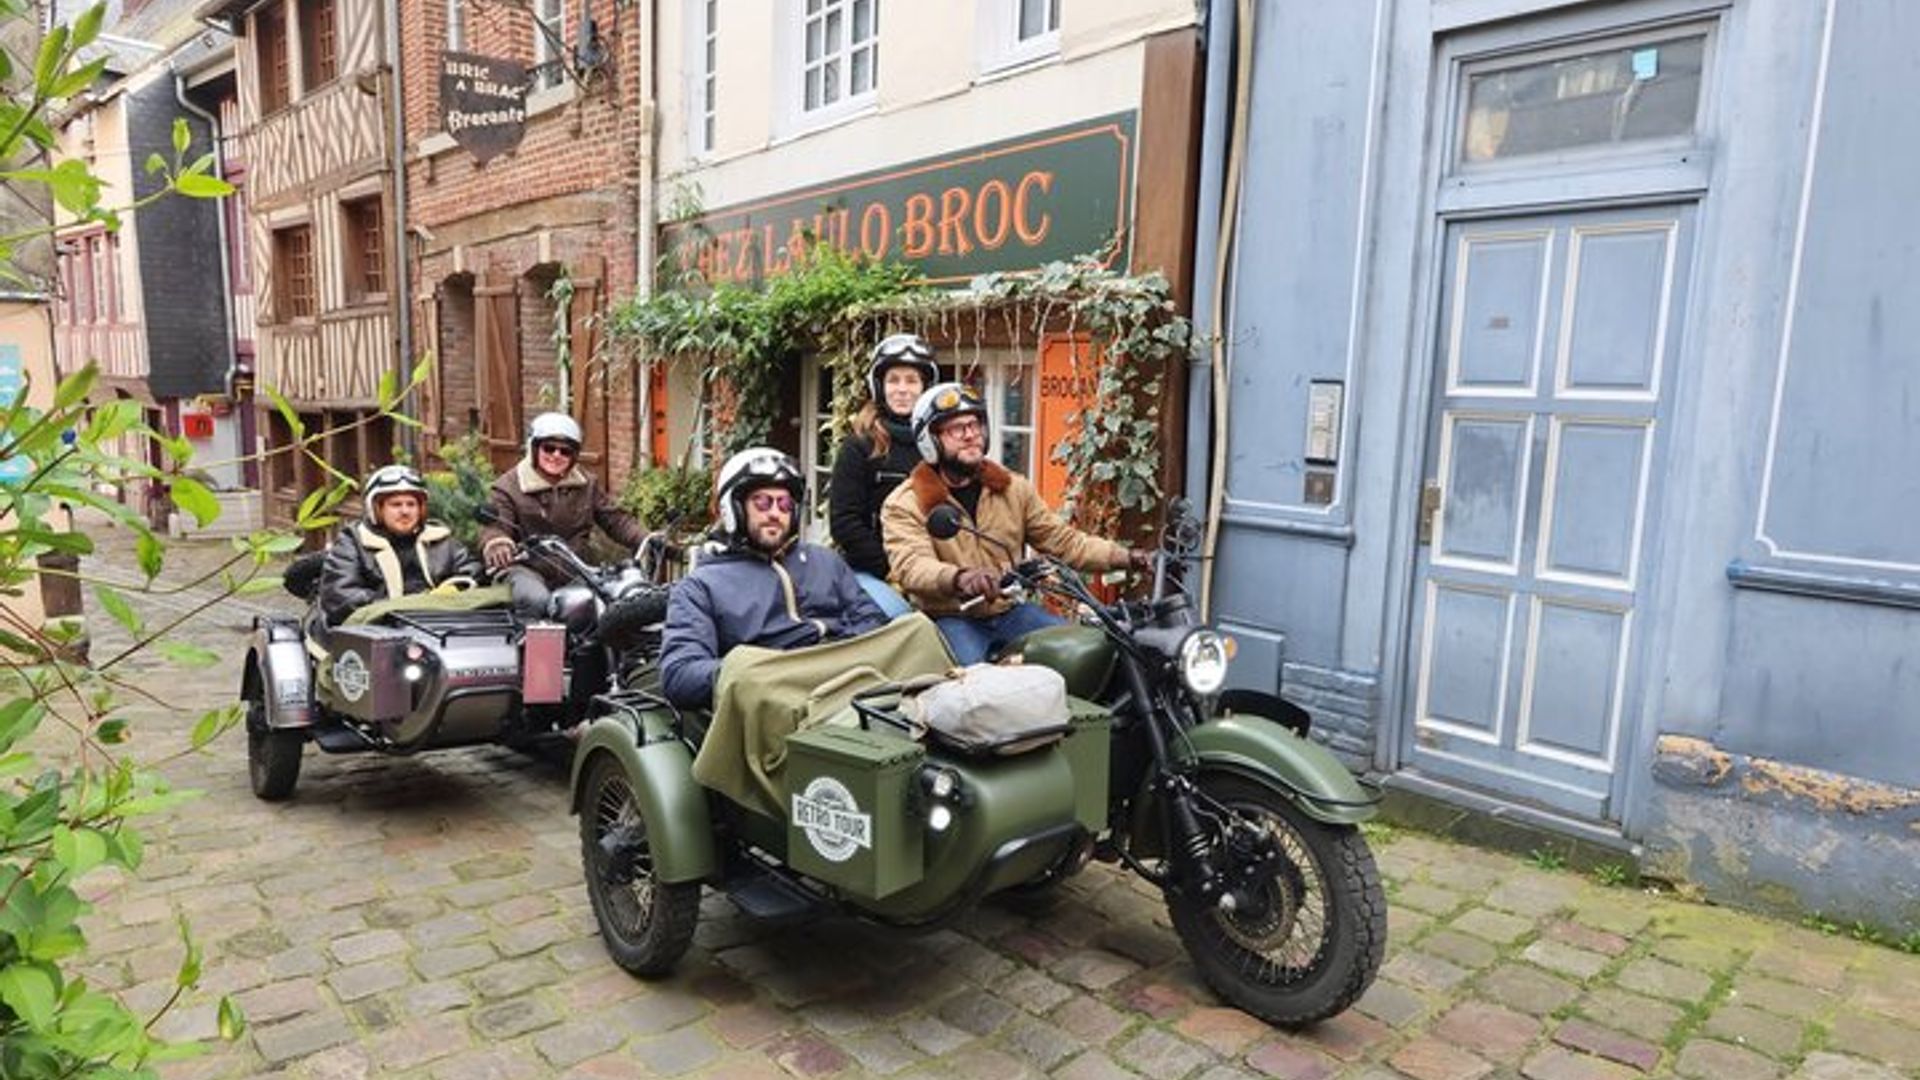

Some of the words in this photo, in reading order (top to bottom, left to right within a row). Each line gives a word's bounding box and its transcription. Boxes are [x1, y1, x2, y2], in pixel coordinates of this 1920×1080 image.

[445, 61, 490, 80] BRIC
[455, 80, 467, 92] A
[474, 81, 525, 100] BRAC
[903, 171, 1054, 259] BROC
[796, 799, 831, 827] RETRO
[834, 813, 866, 841] TOUR
